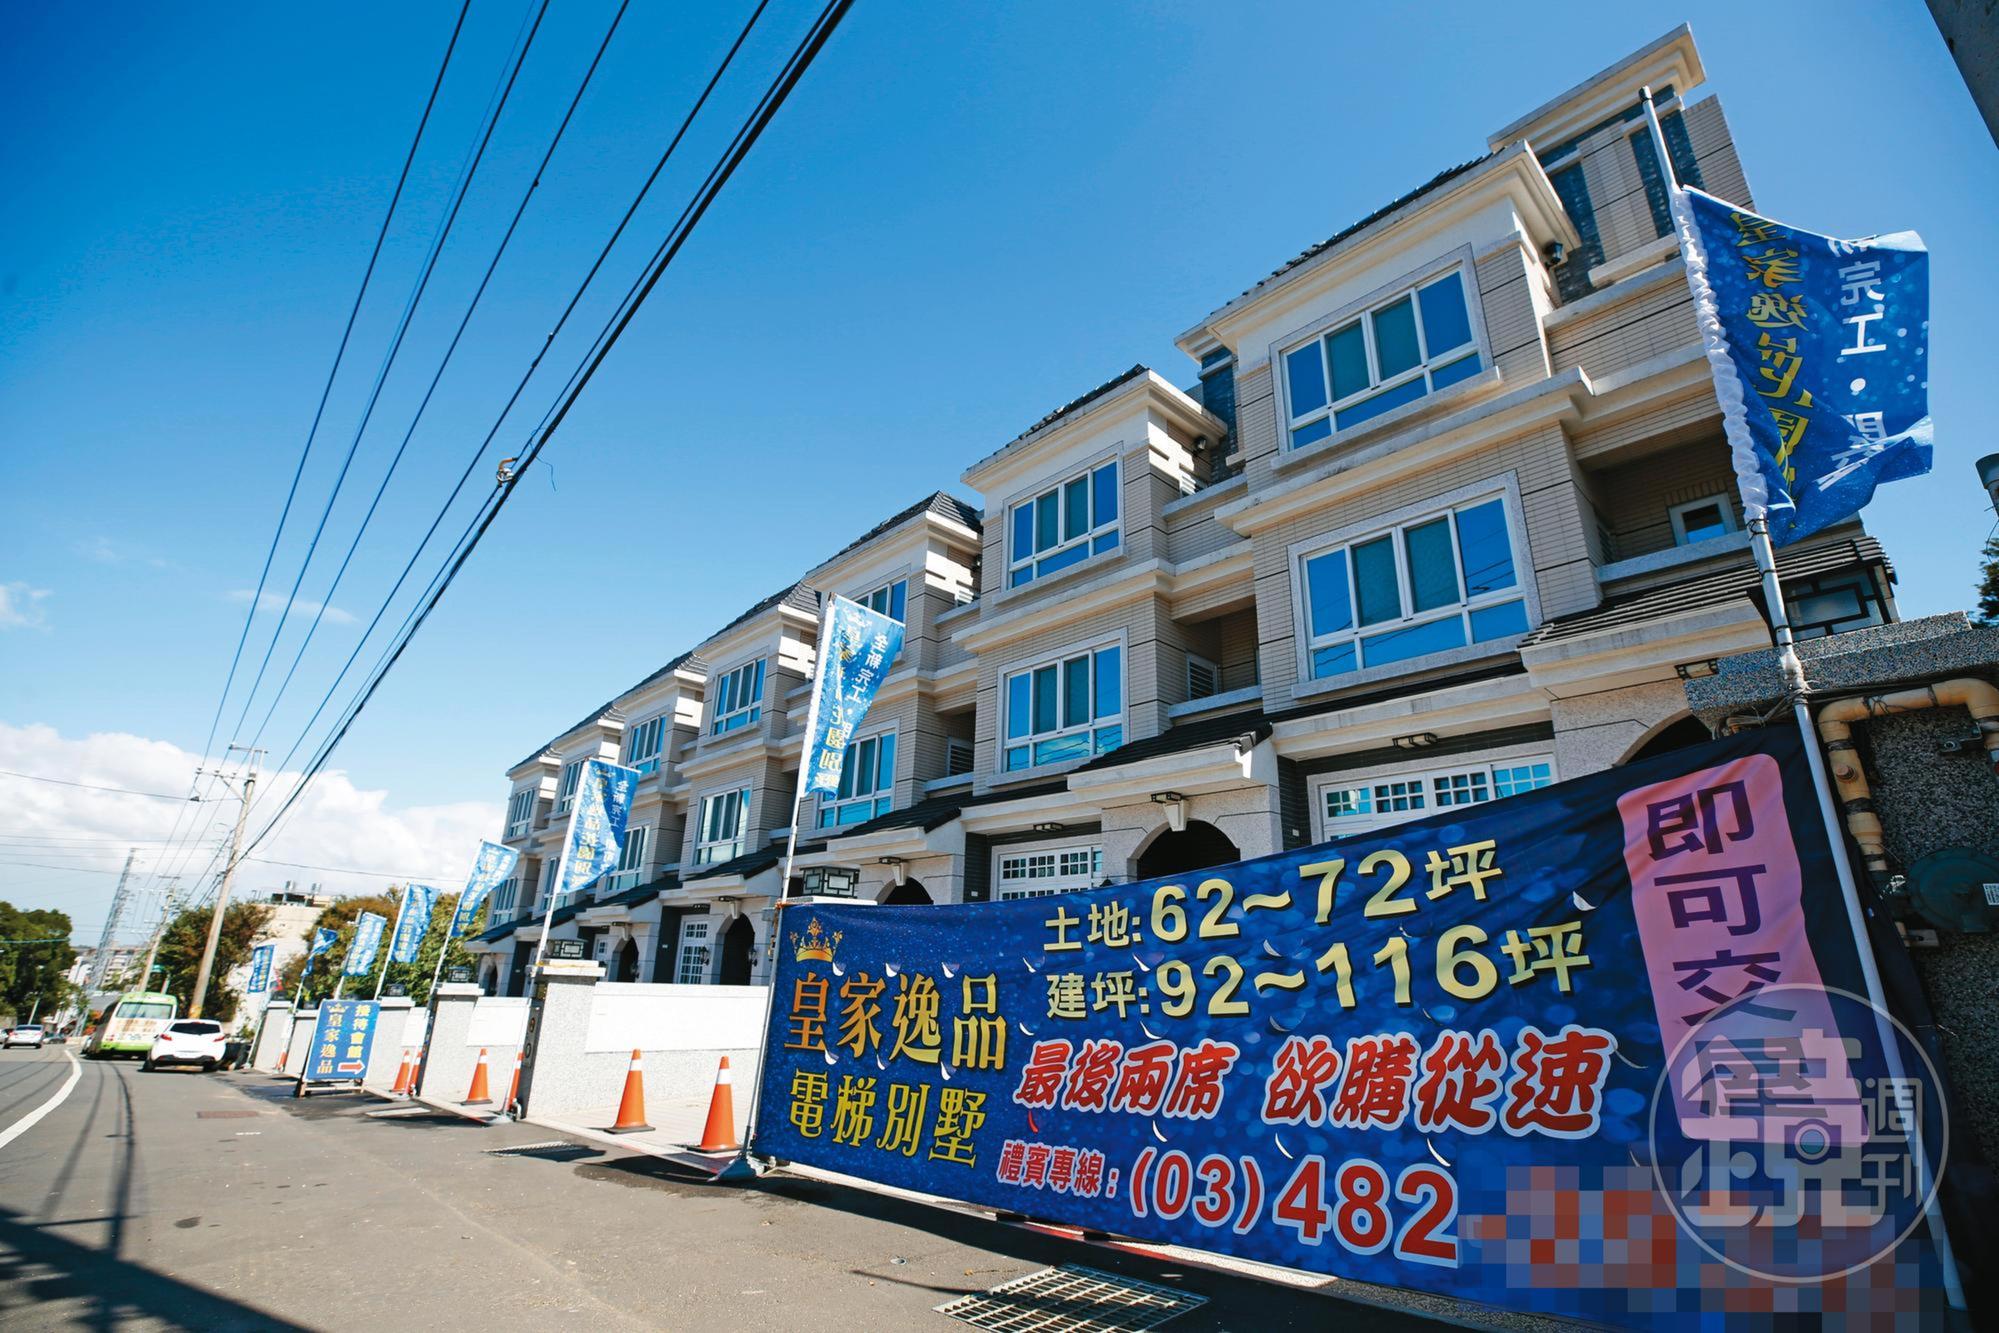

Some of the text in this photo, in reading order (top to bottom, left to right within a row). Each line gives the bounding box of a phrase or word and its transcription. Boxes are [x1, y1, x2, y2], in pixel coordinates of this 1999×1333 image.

[1645, 780, 1828, 1117] 即可交屋
[784, 971, 1007, 1071] 皇家逸品
[788, 1069, 987, 1168] 電梯別墅
[1014, 1024, 1616, 1138] 最後兩席 欲購從速
